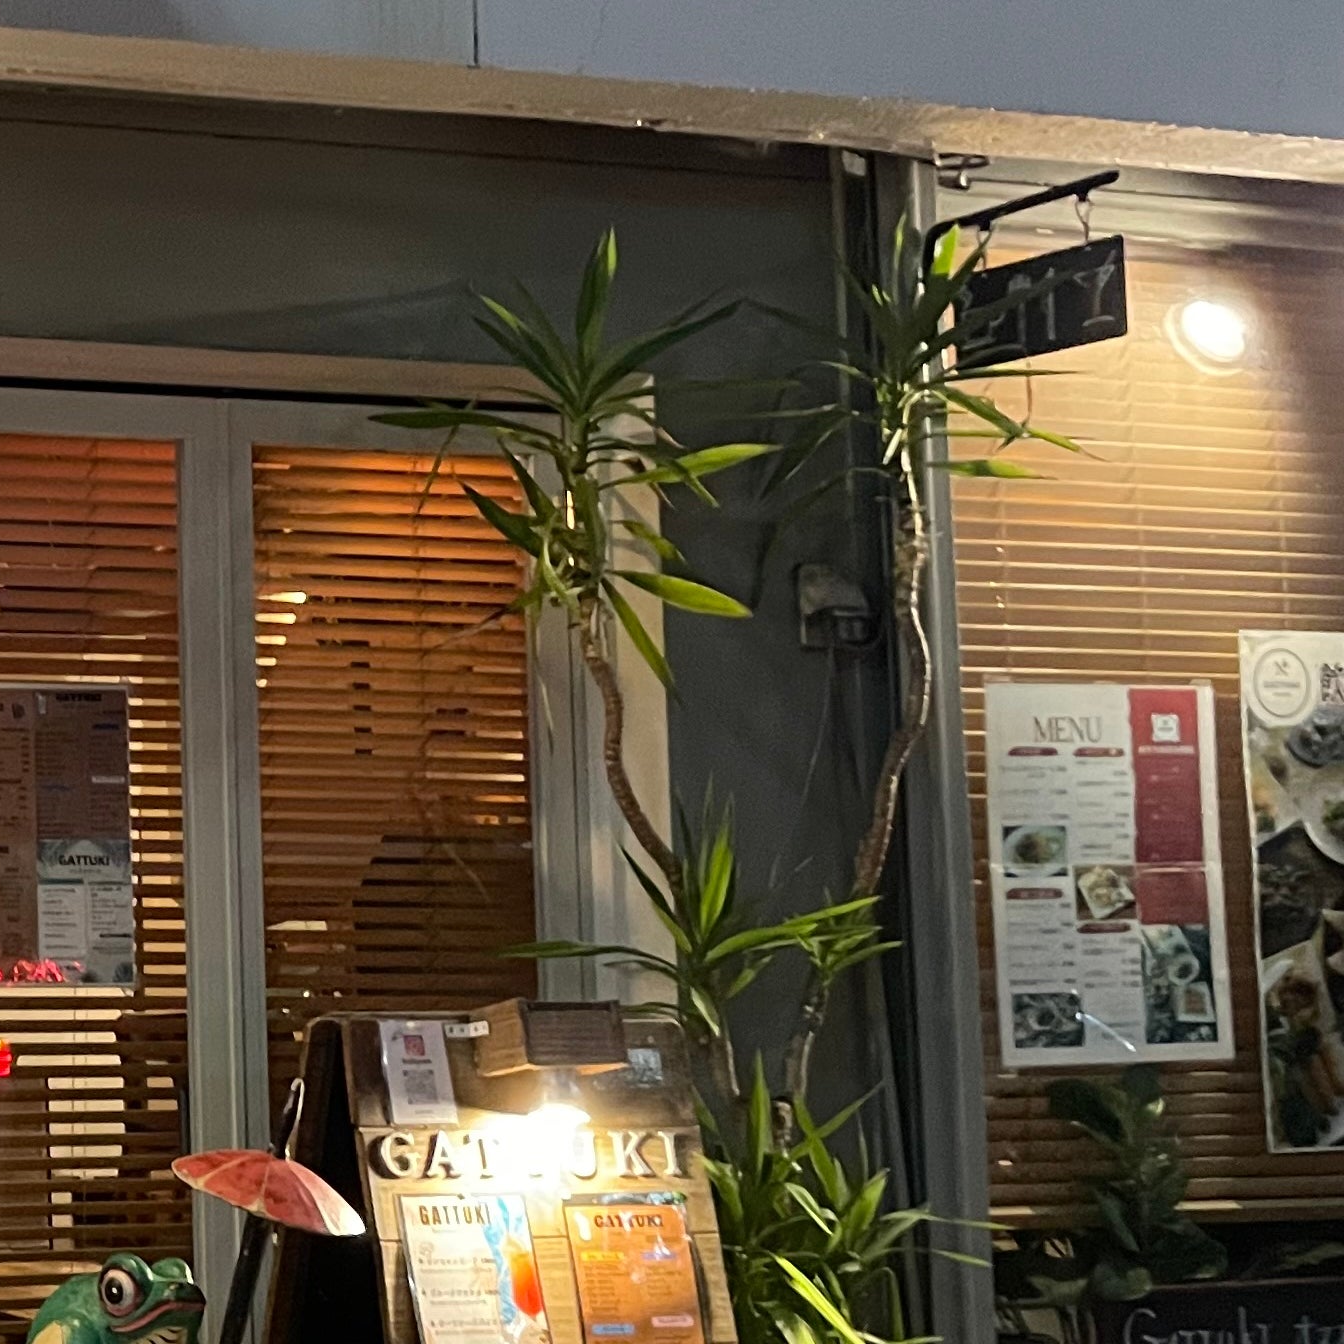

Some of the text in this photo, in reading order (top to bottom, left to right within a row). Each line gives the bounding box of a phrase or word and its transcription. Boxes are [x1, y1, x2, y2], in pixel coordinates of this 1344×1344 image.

[1033, 716, 1102, 743] MENU
[59, 855, 109, 866] GATTUKI
[379, 1129, 682, 1179] GATUKI
[418, 1202, 492, 1226] GATTUKI
